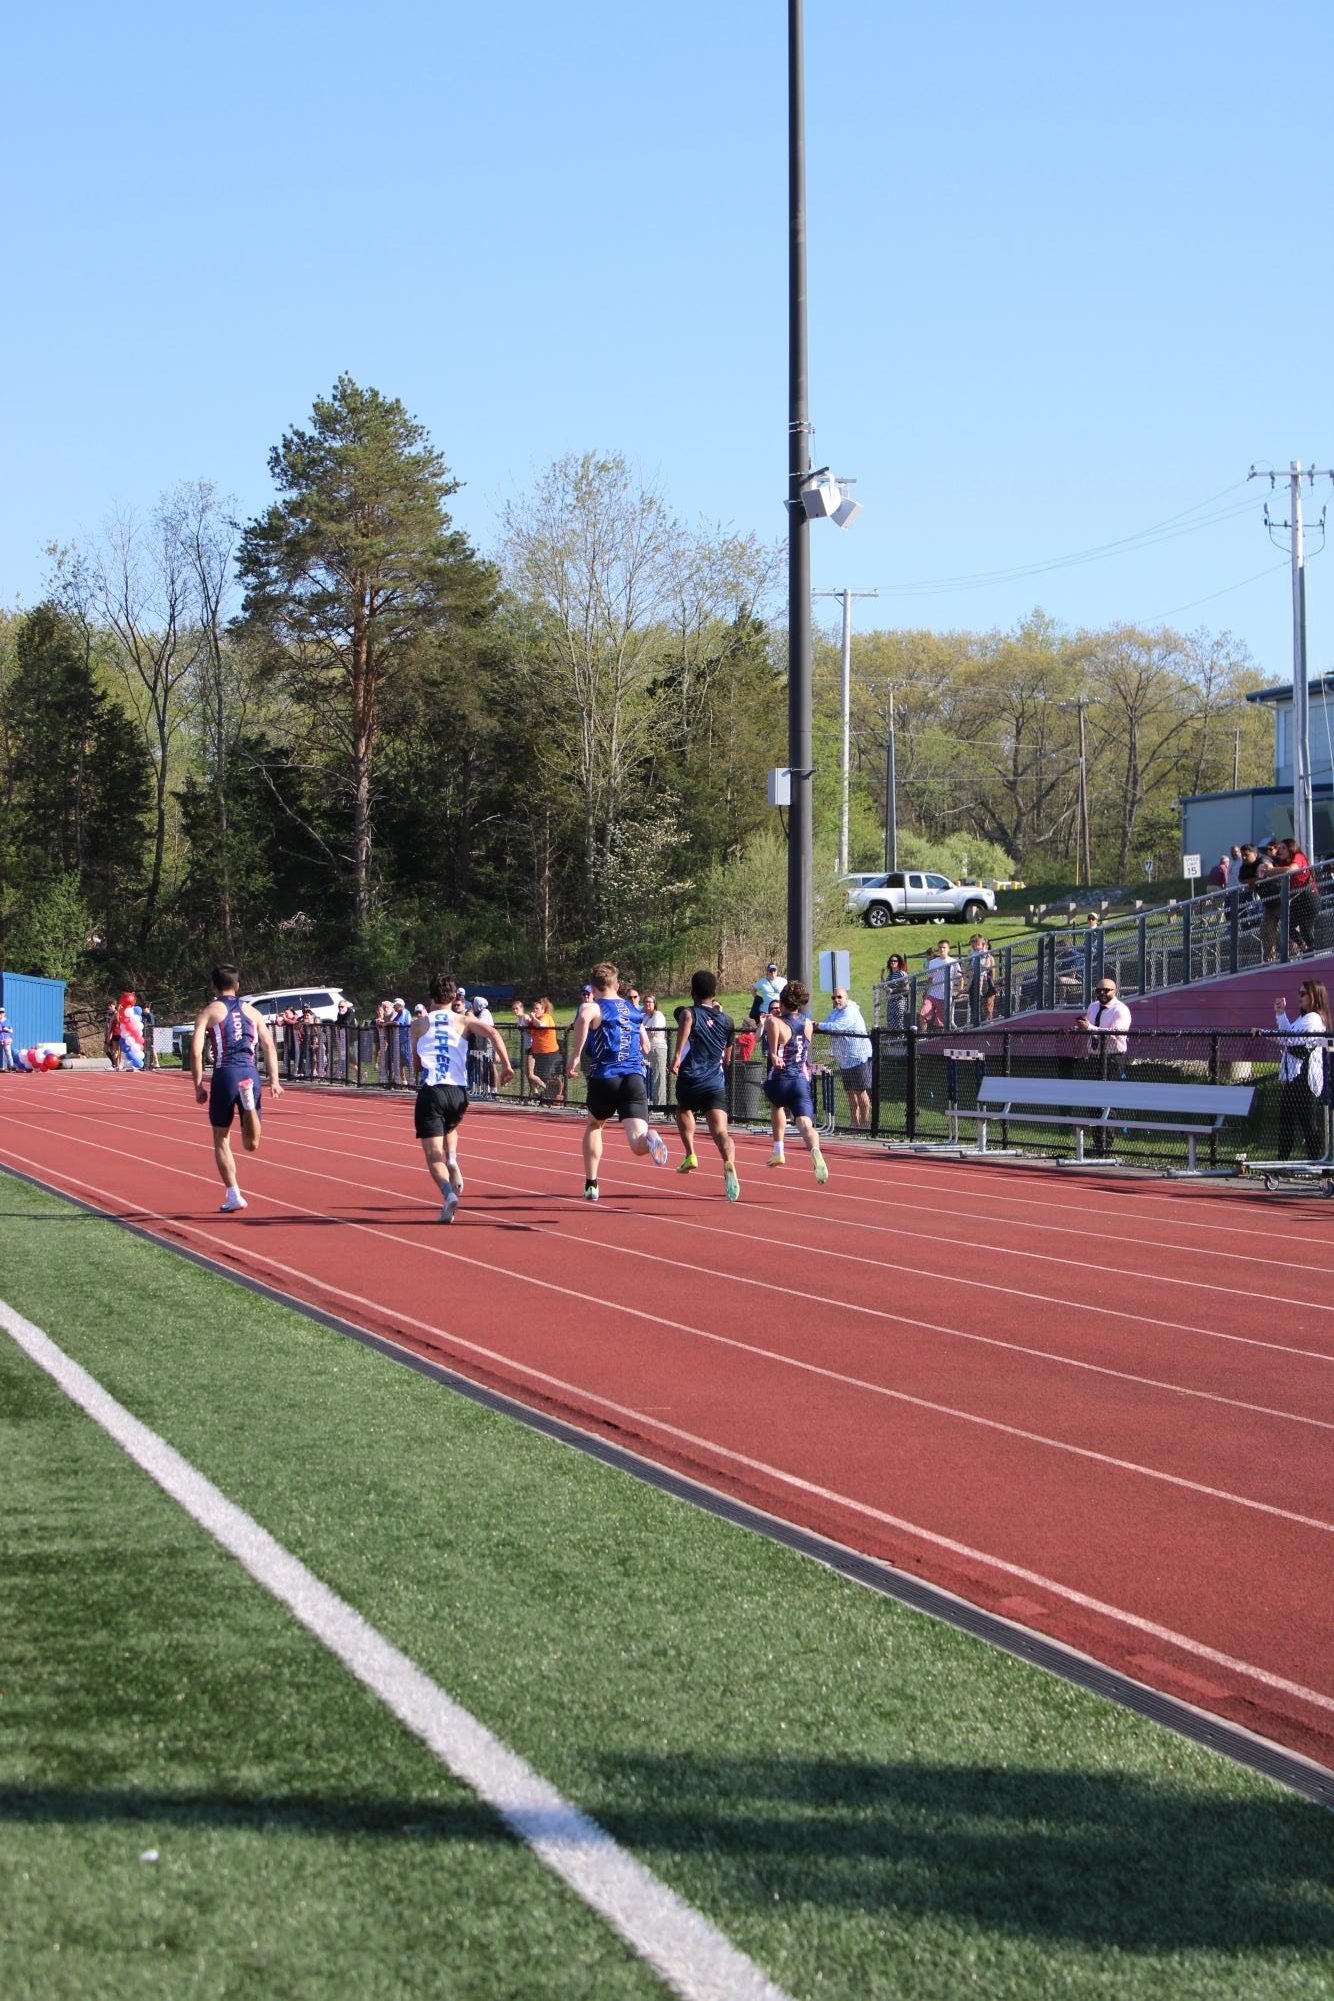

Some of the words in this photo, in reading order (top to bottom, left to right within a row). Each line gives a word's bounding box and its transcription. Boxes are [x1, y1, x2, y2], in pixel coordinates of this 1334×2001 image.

[1187, 867, 1197, 875] 15
[231, 1012, 243, 1041] LIONS
[795, 1035, 804, 1063] LIONS
